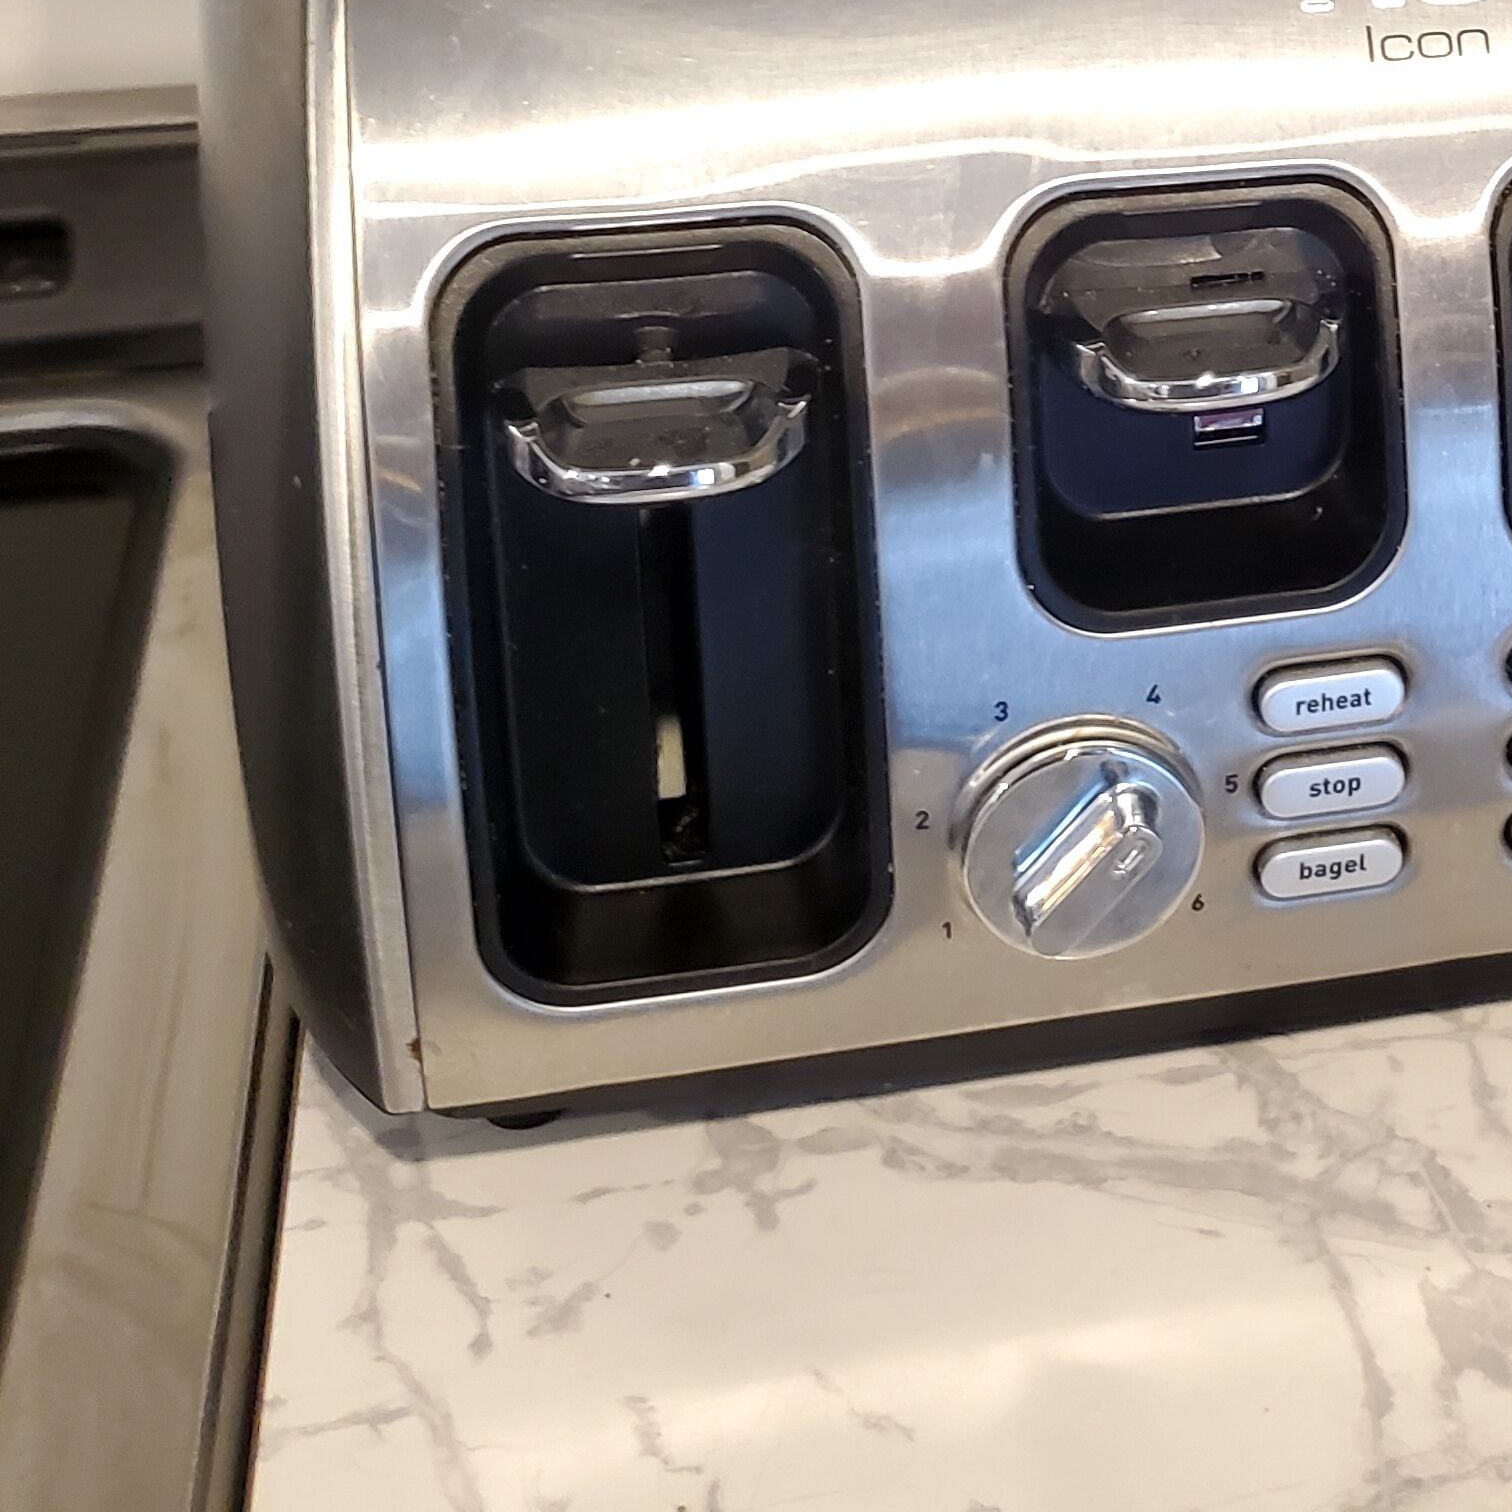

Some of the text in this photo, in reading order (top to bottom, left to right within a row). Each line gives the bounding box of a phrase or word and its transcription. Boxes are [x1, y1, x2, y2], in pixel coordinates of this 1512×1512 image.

[1365, 25, 1490, 62] Icon
[1146, 684, 1161, 705] 4
[1295, 687, 1373, 716] reheat
[994, 701, 1009, 722] 3
[1225, 774, 1239, 793] 5
[1309, 775, 1362, 799] stop
[915, 811, 930, 830] 2
[1299, 854, 1367, 882] bagel
[1191, 894, 1205, 911] 6
[942, 922, 952, 939] 1
